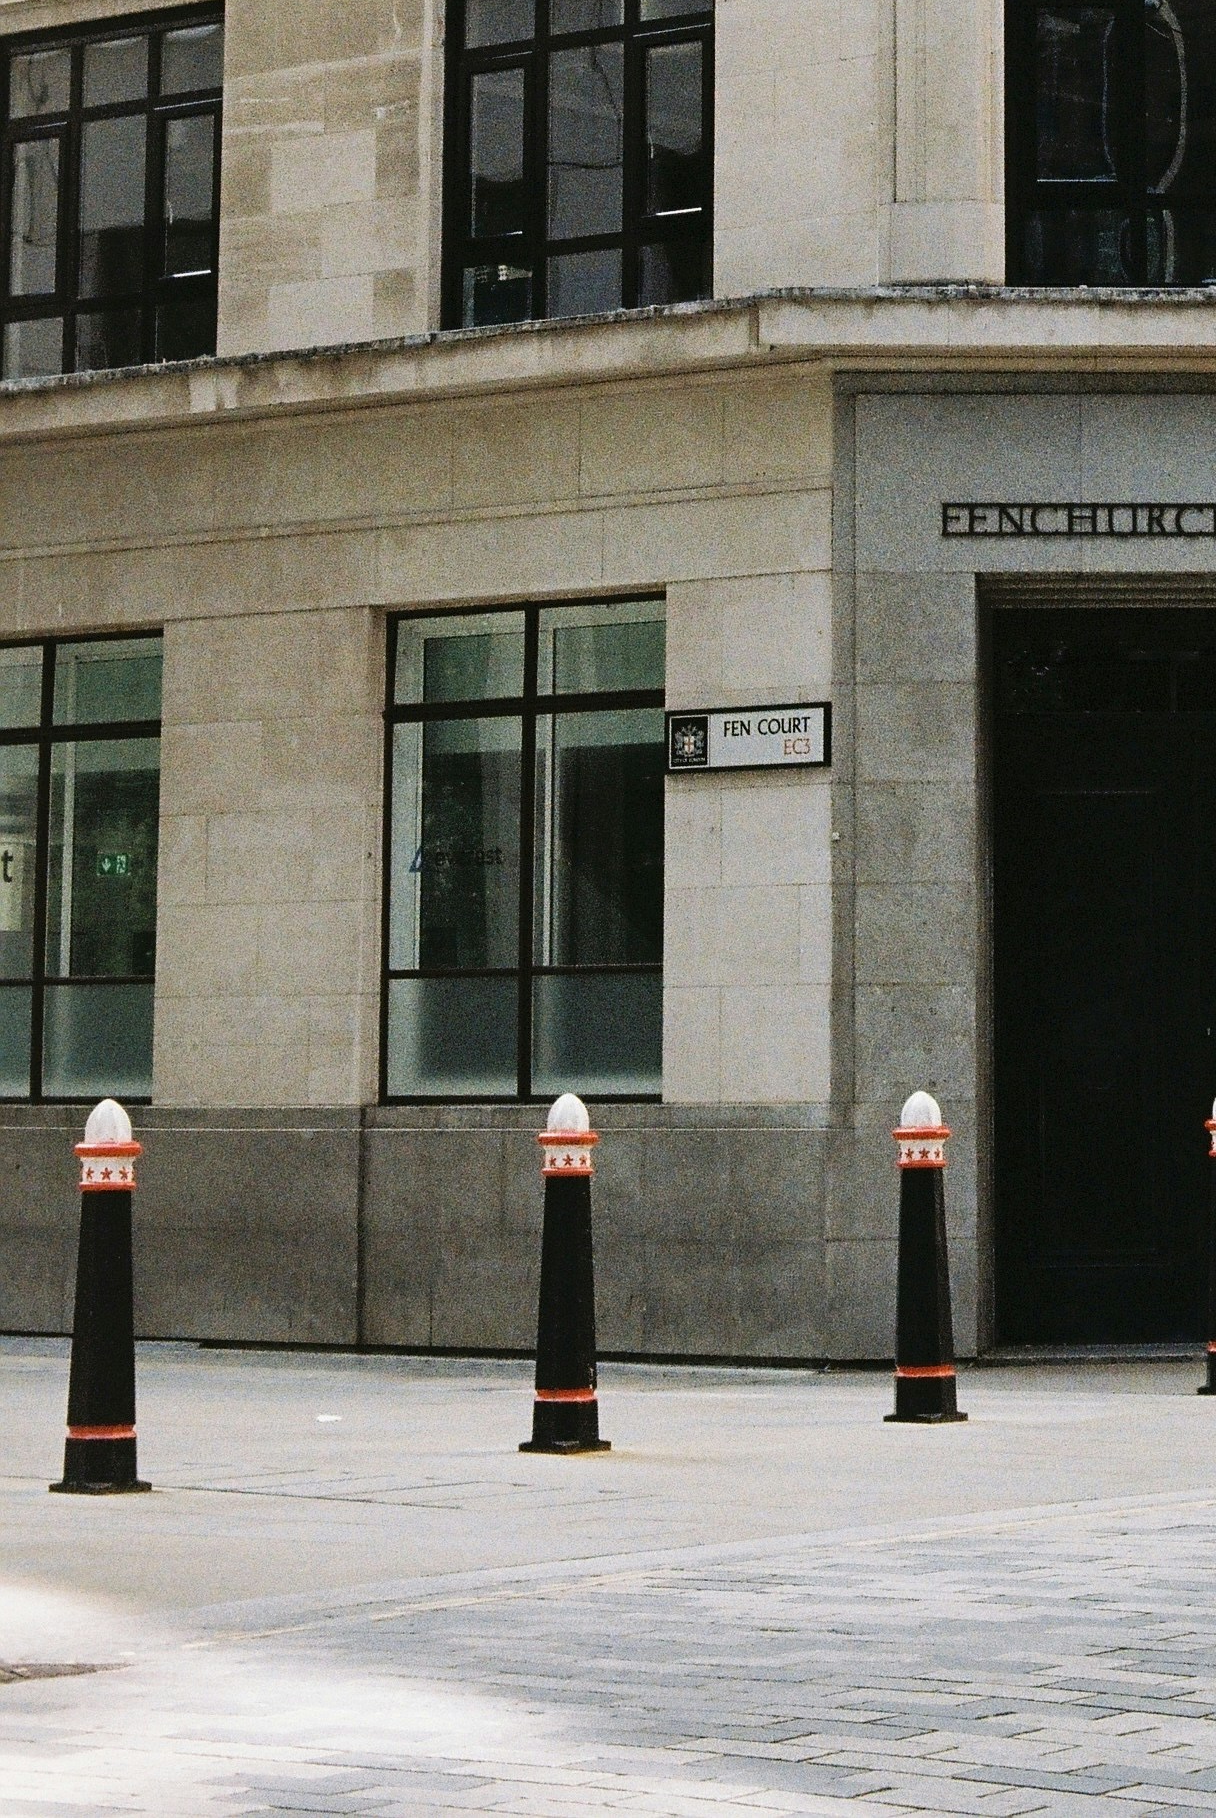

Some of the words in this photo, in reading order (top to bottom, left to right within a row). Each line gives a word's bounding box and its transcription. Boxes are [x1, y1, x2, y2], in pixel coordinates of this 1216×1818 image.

[723, 720, 751, 738] FEN
[757, 716, 811, 736] COURT
[783, 738, 811, 756] EC3
